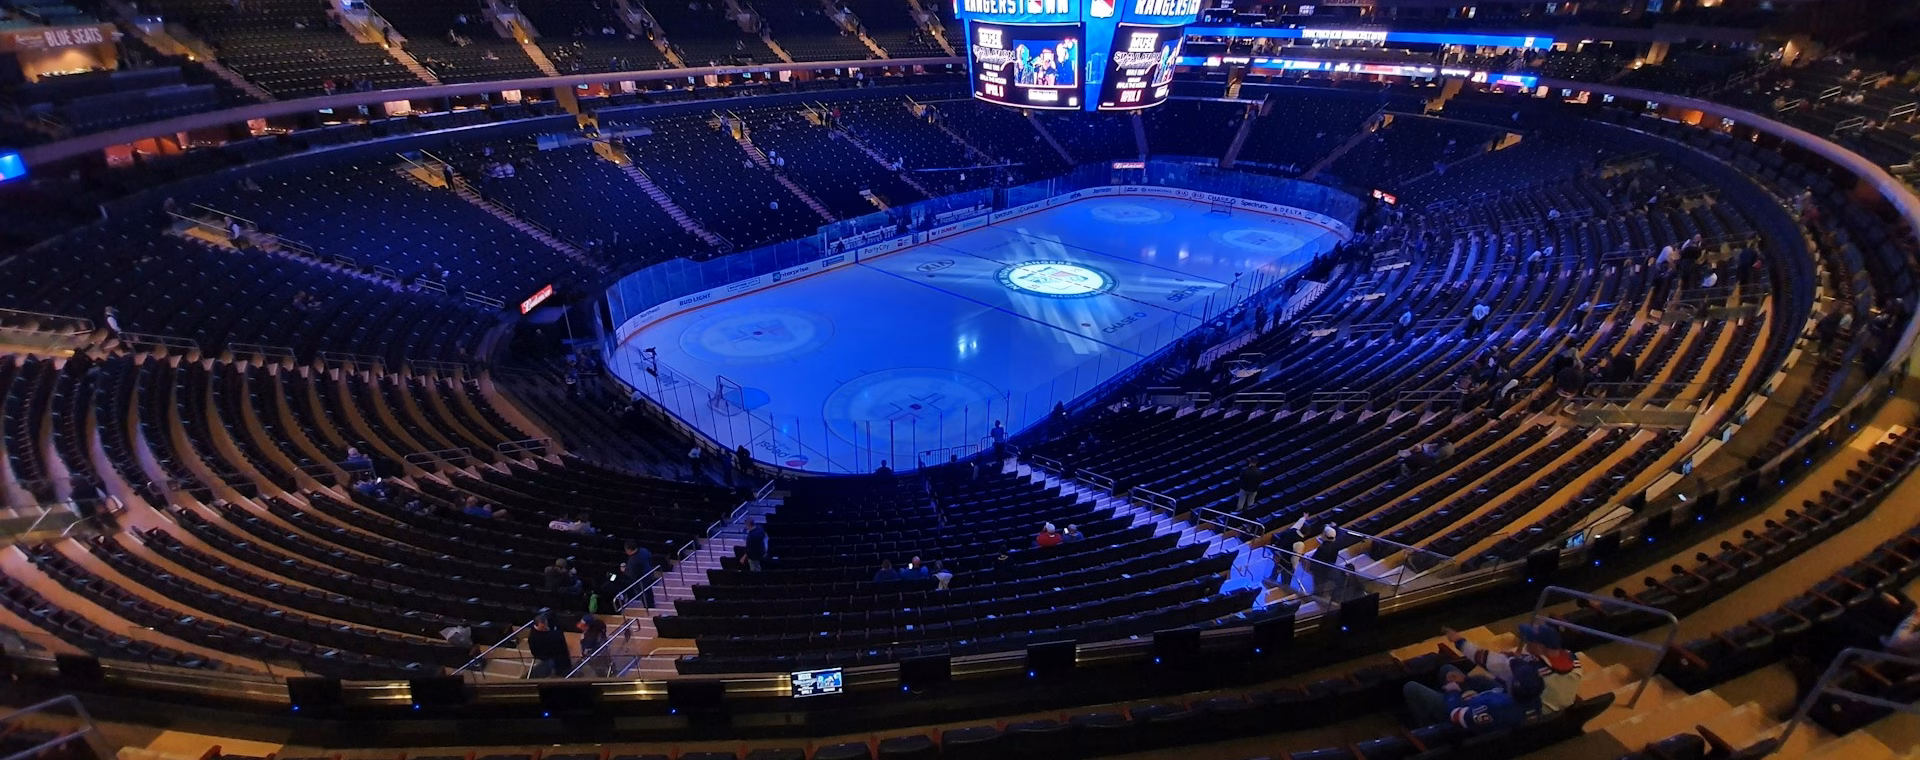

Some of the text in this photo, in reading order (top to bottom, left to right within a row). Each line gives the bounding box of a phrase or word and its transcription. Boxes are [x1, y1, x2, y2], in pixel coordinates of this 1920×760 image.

[45, 30, 73, 47] BLUE
[71, 28, 102, 44] SEATS
[1208, 195, 1230, 203] CHASE
[1280, 207, 1302, 216] DELTA
[680, 293, 711, 306] BUD LIGHT
[1102, 315, 1139, 333] CHASE
